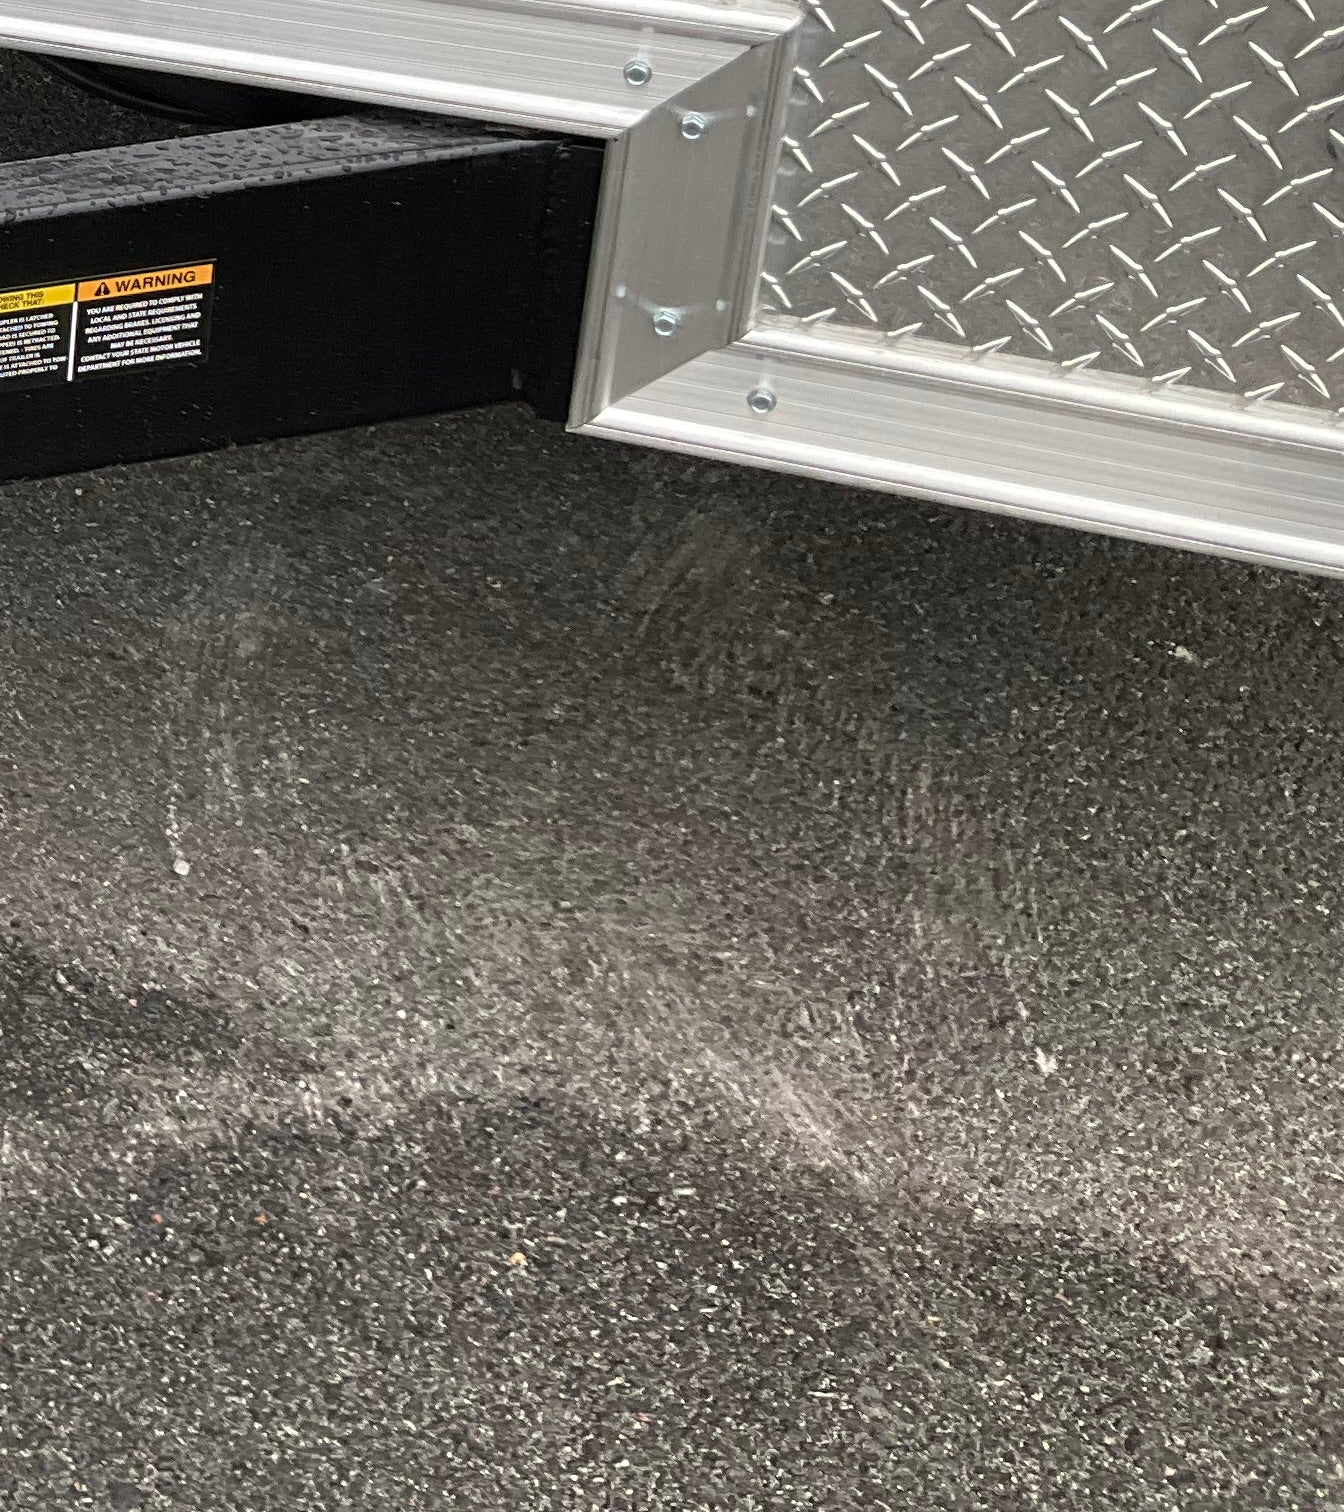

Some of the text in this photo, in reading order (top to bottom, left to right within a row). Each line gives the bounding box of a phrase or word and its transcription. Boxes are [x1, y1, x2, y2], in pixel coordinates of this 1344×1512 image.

[116, 271, 196, 292] WARNING
[27, 290, 43, 299] THIS
[86, 307, 100, 315] YOU
[90, 315, 110, 324] LOCAL
[112, 312, 126, 321] AND
[127, 310, 146, 319] STATE
[186, 312, 201, 320] AND
